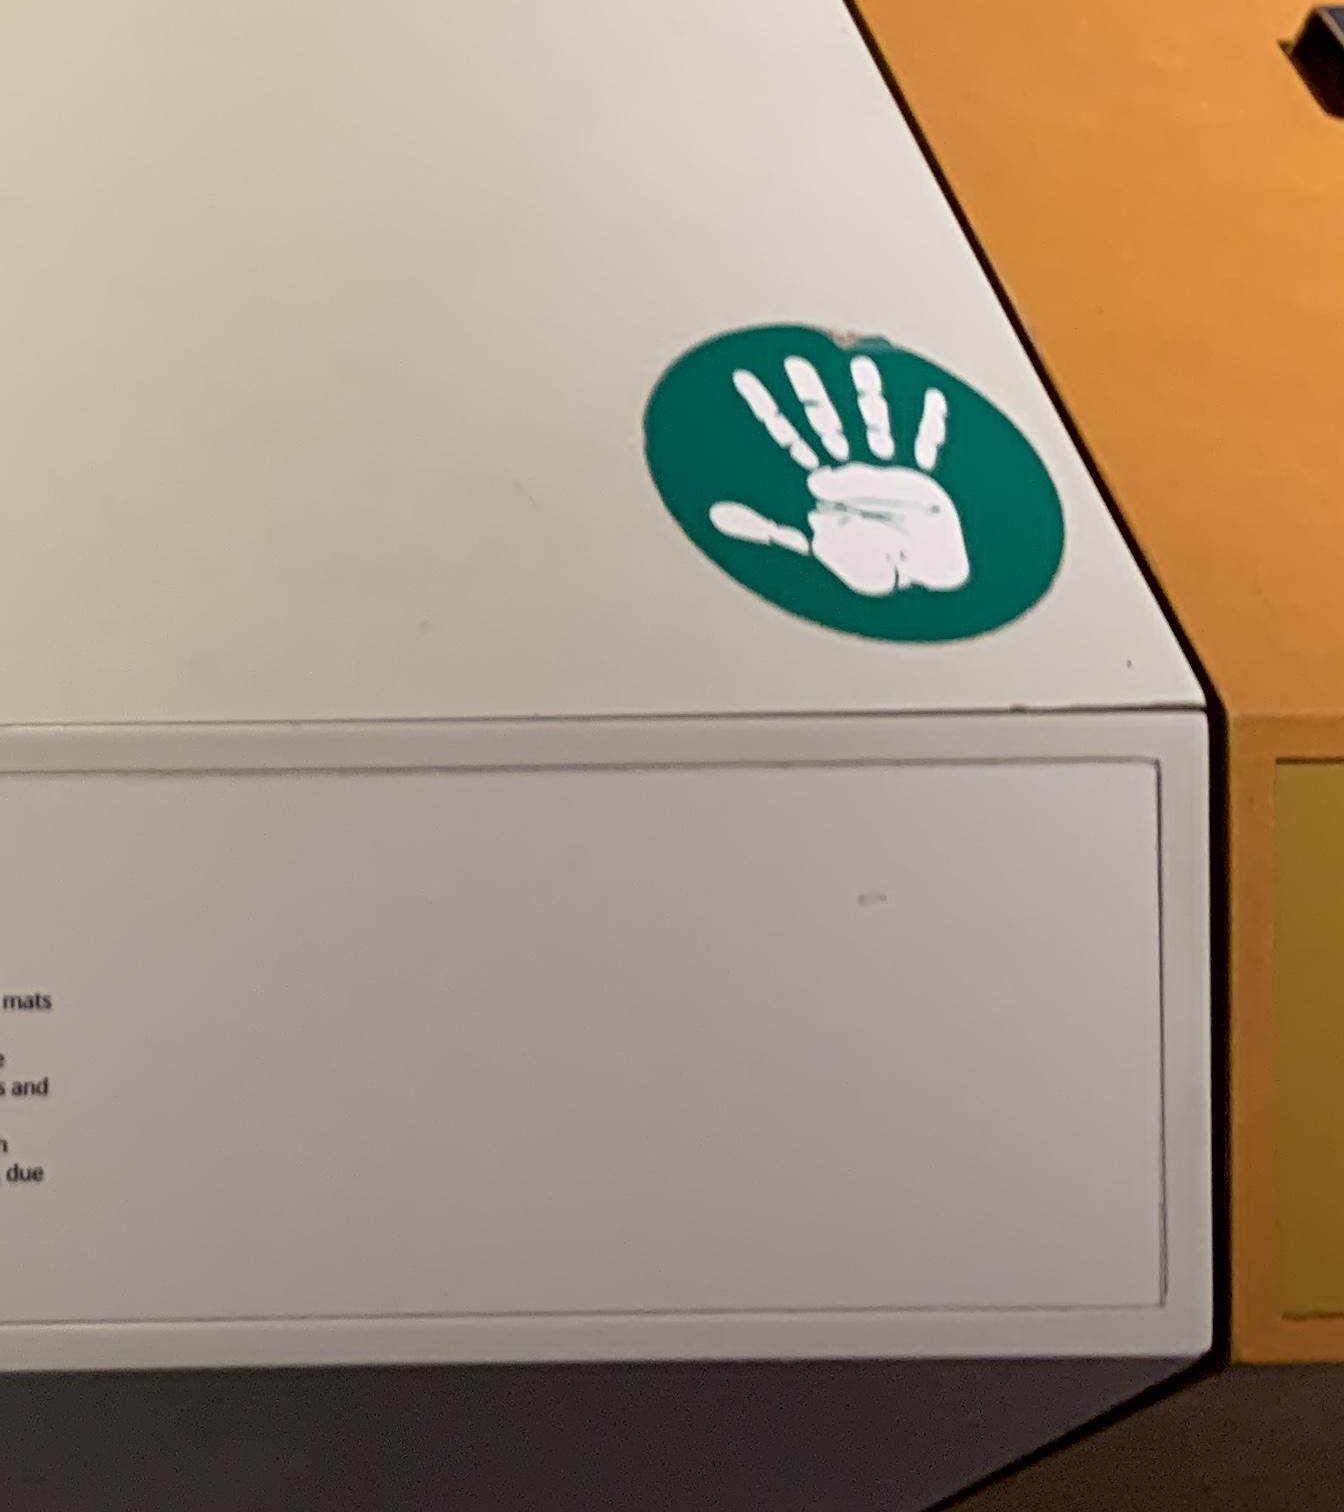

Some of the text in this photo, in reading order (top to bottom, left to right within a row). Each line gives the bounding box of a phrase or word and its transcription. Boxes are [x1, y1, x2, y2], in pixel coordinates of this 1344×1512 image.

[2, 992, 52, 1011] mats
[11, 1076, 48, 1097] and
[5, 1162, 44, 1183] due
